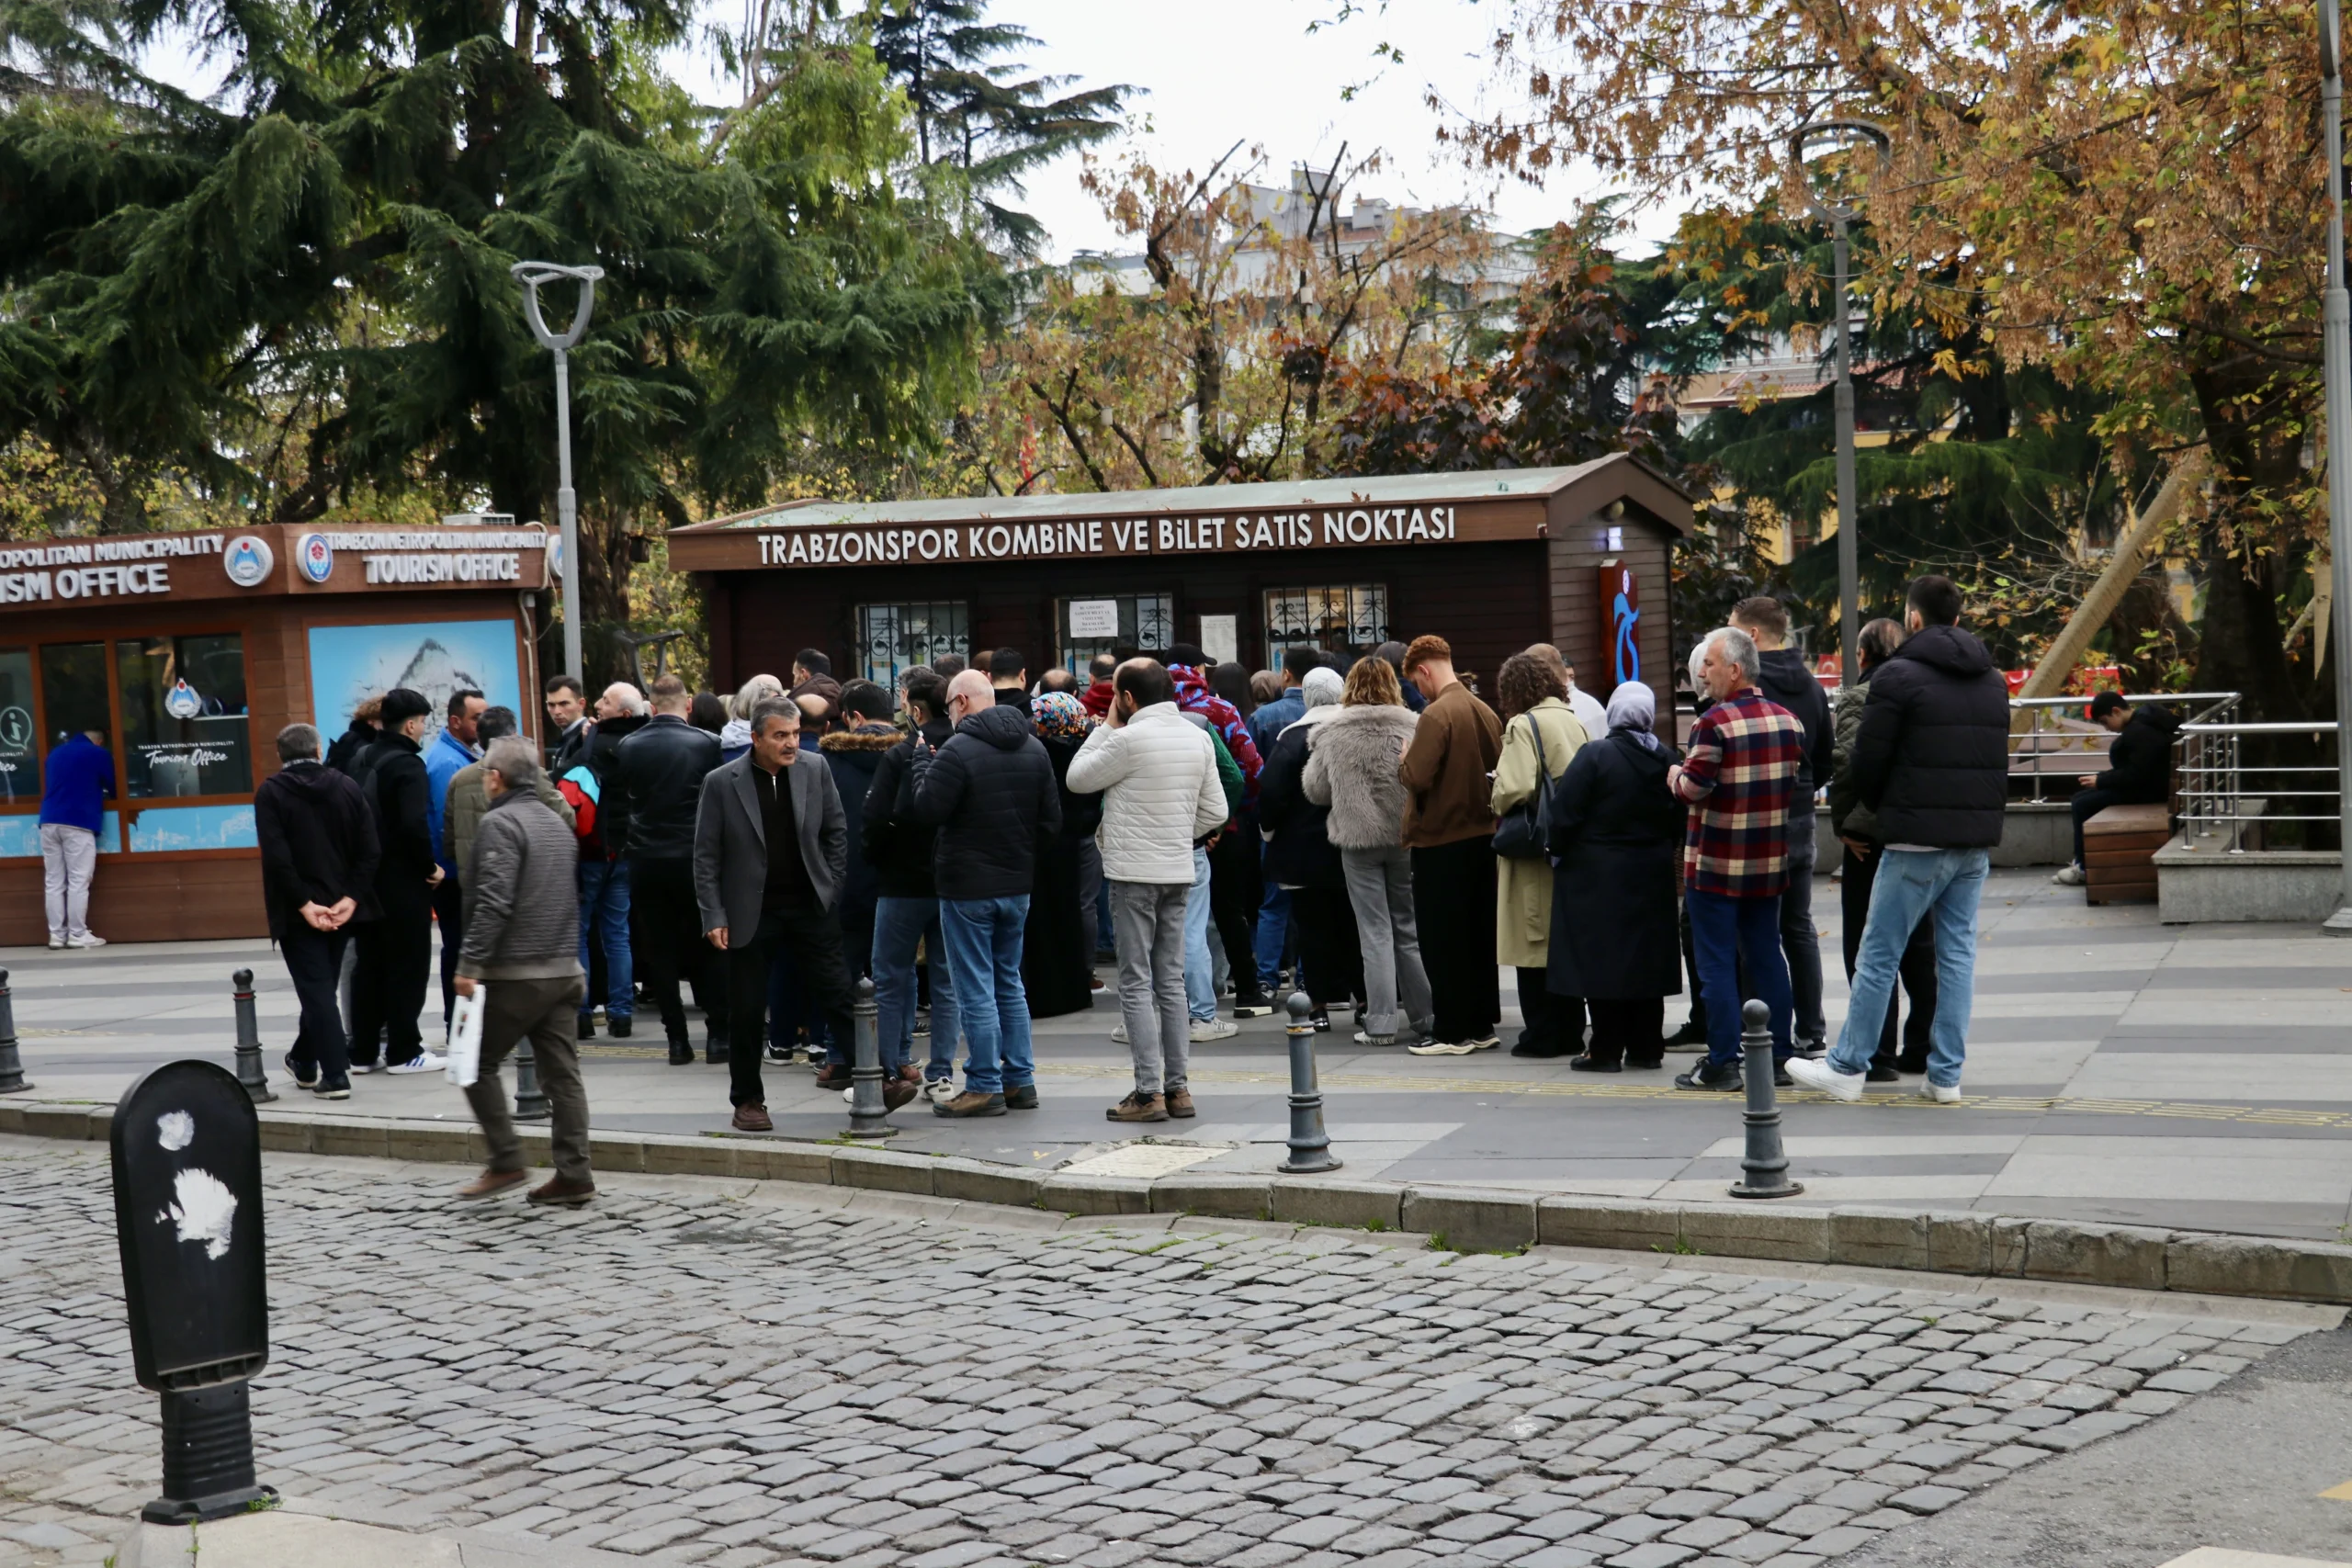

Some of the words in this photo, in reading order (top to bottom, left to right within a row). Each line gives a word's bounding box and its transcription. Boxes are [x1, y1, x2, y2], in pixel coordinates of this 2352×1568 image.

[94, 535, 225, 562] MUNICIPALITY
[325, 532, 386, 550] TRABZON
[387, 532, 474, 549] METROPOLITAN
[476, 532, 547, 548] MUNICIPALITY
[758, 528, 959, 565] TRABZONSPOR
[1111, 520, 1148, 551] VE
[1323, 507, 1454, 544] NOKTASI
[56, 563, 171, 599] OFFICE
[363, 554, 454, 584] TOURISM
[453, 553, 521, 581] OFFICE
[145, 750, 188, 769] Tourism
[190, 749, 228, 766] Office
